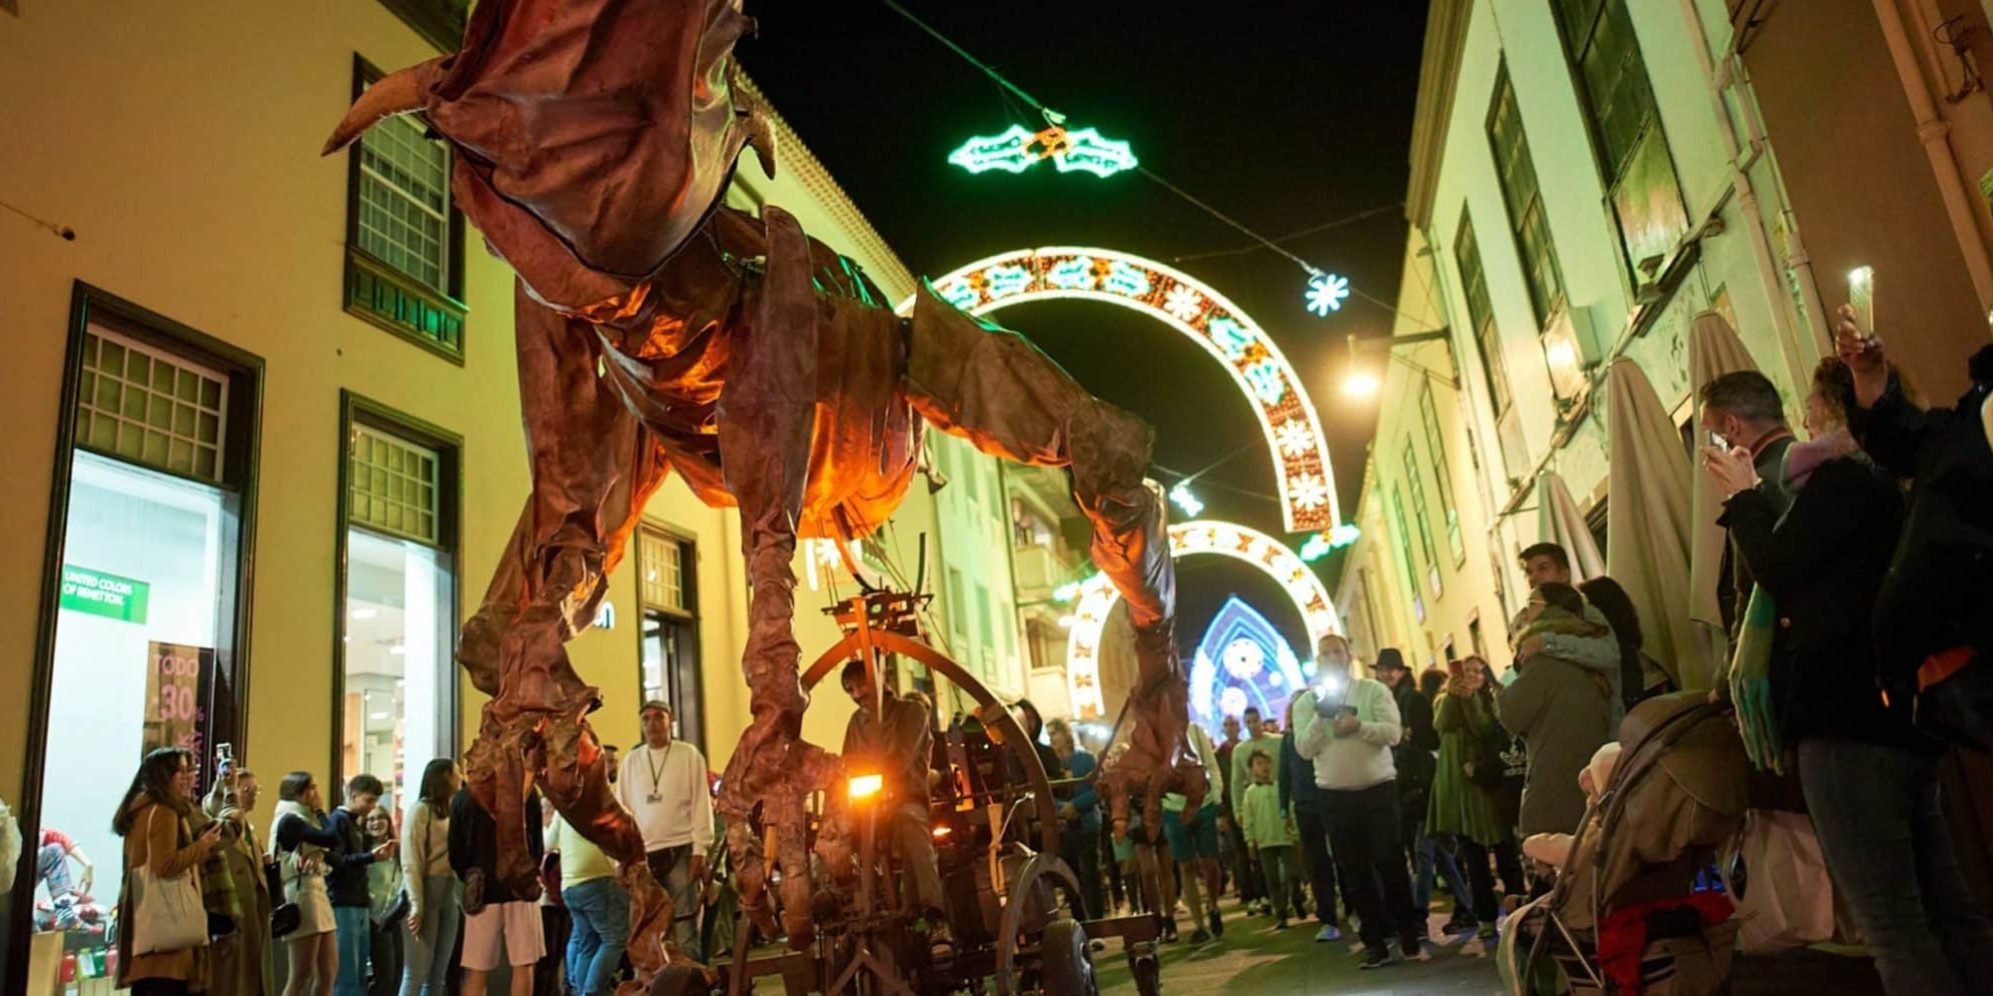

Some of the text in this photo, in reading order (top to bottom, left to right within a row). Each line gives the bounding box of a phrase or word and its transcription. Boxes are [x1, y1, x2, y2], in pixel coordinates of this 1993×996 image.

[62, 583, 77, 594] OF
[64, 572, 133, 595] UNITED COLORS
[152, 653, 199, 676] TODO
